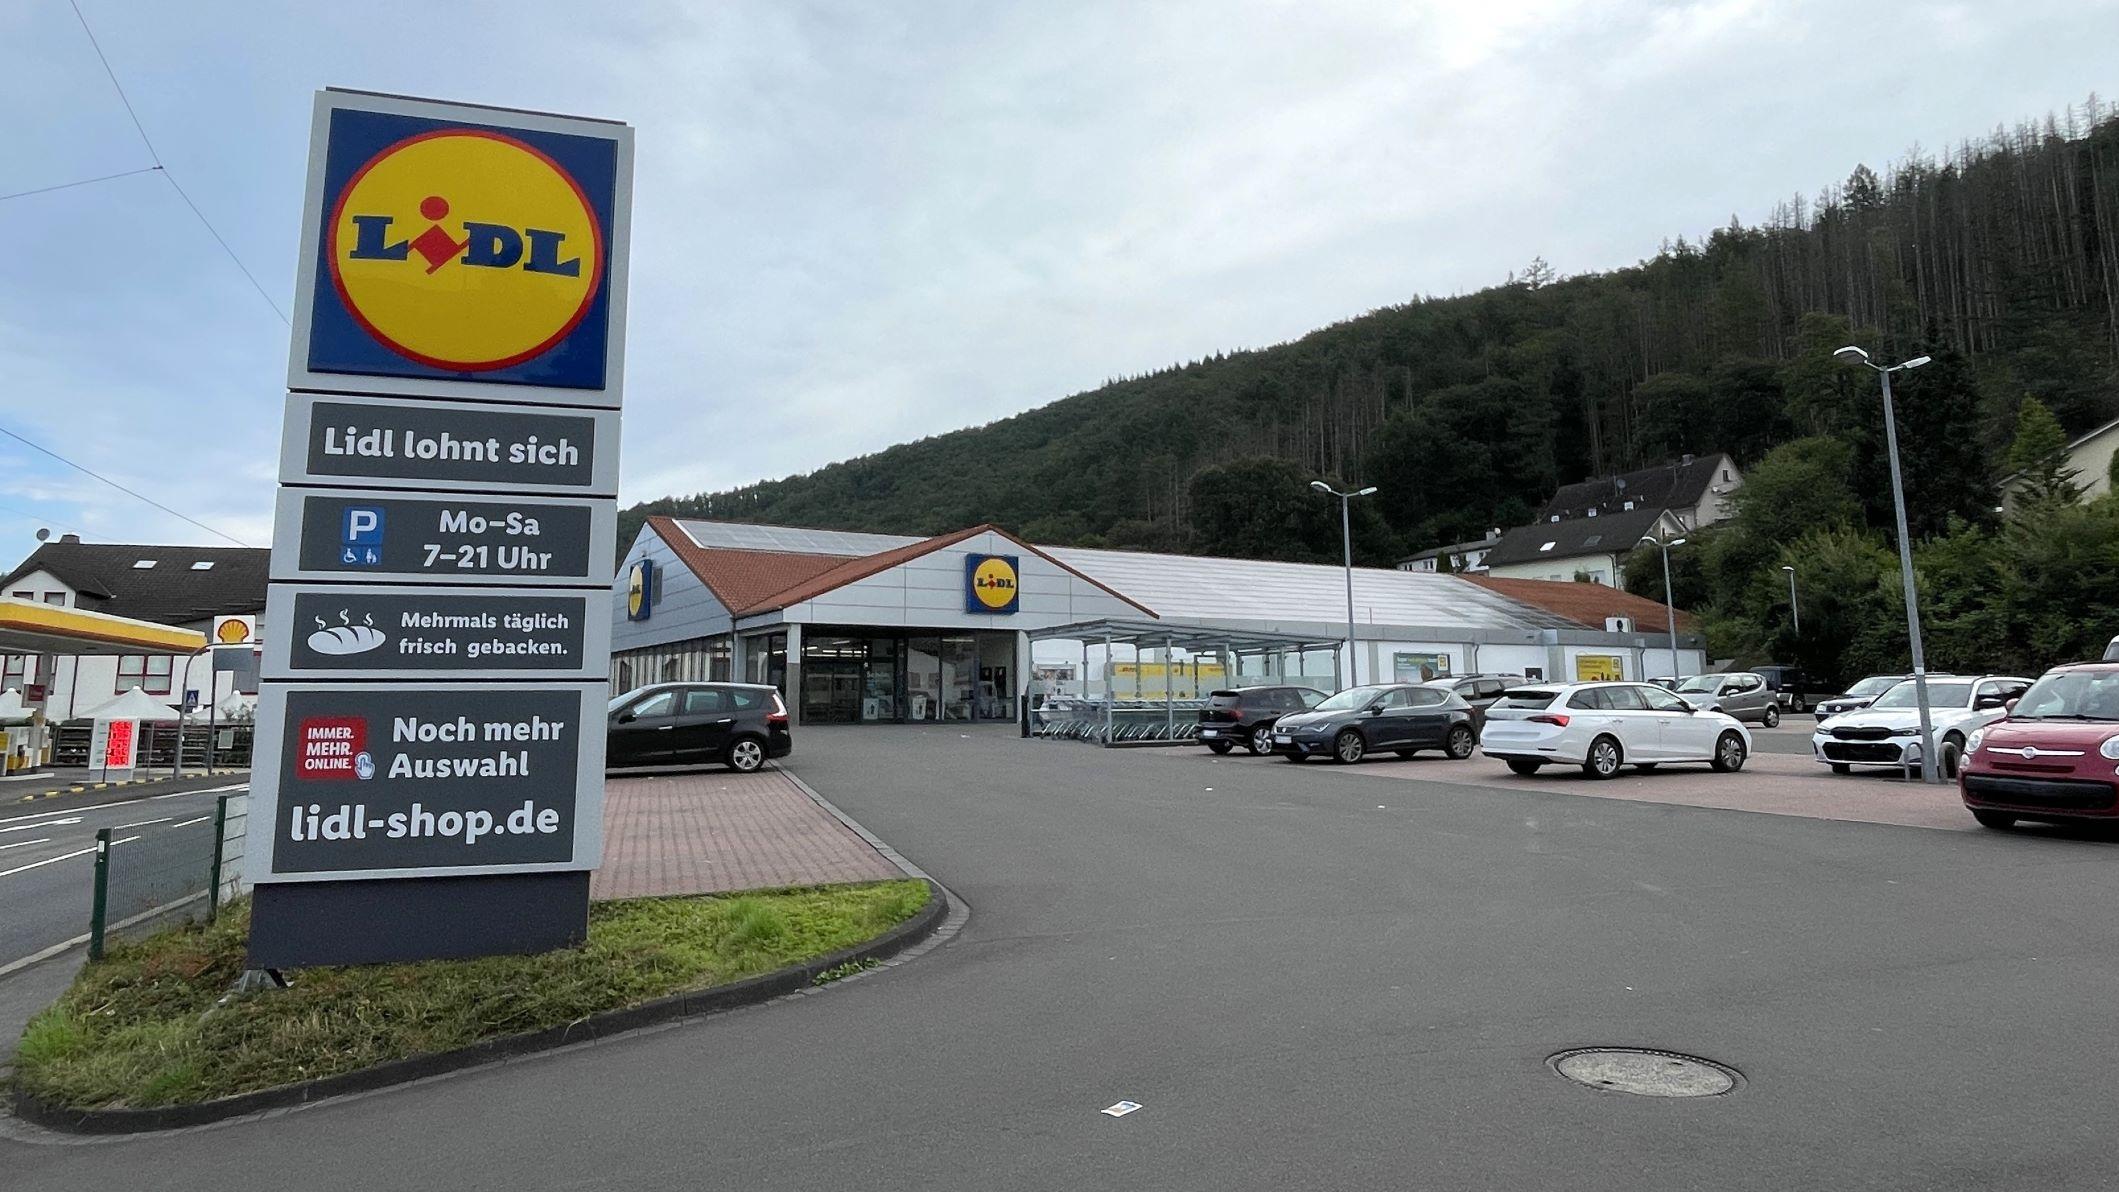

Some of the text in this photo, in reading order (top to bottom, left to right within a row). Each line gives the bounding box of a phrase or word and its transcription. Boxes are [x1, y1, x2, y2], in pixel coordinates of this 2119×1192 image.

[324, 426, 579, 466] Lidl lohnt sich
[348, 510, 377, 541] P
[497, 545, 552, 570] Uhr
[401, 612, 569, 633] Mehrmals täglich
[399, 638, 569, 659] frisch gebacken.
[306, 726, 355, 740] IMMER.
[392, 715, 564, 742] Noch mehr
[305, 741, 354, 756] MEHR.
[303, 757, 352, 771] ONLINE.
[387, 751, 530, 779] Auswahl
[290, 800, 560, 844] lidl-shop.de
